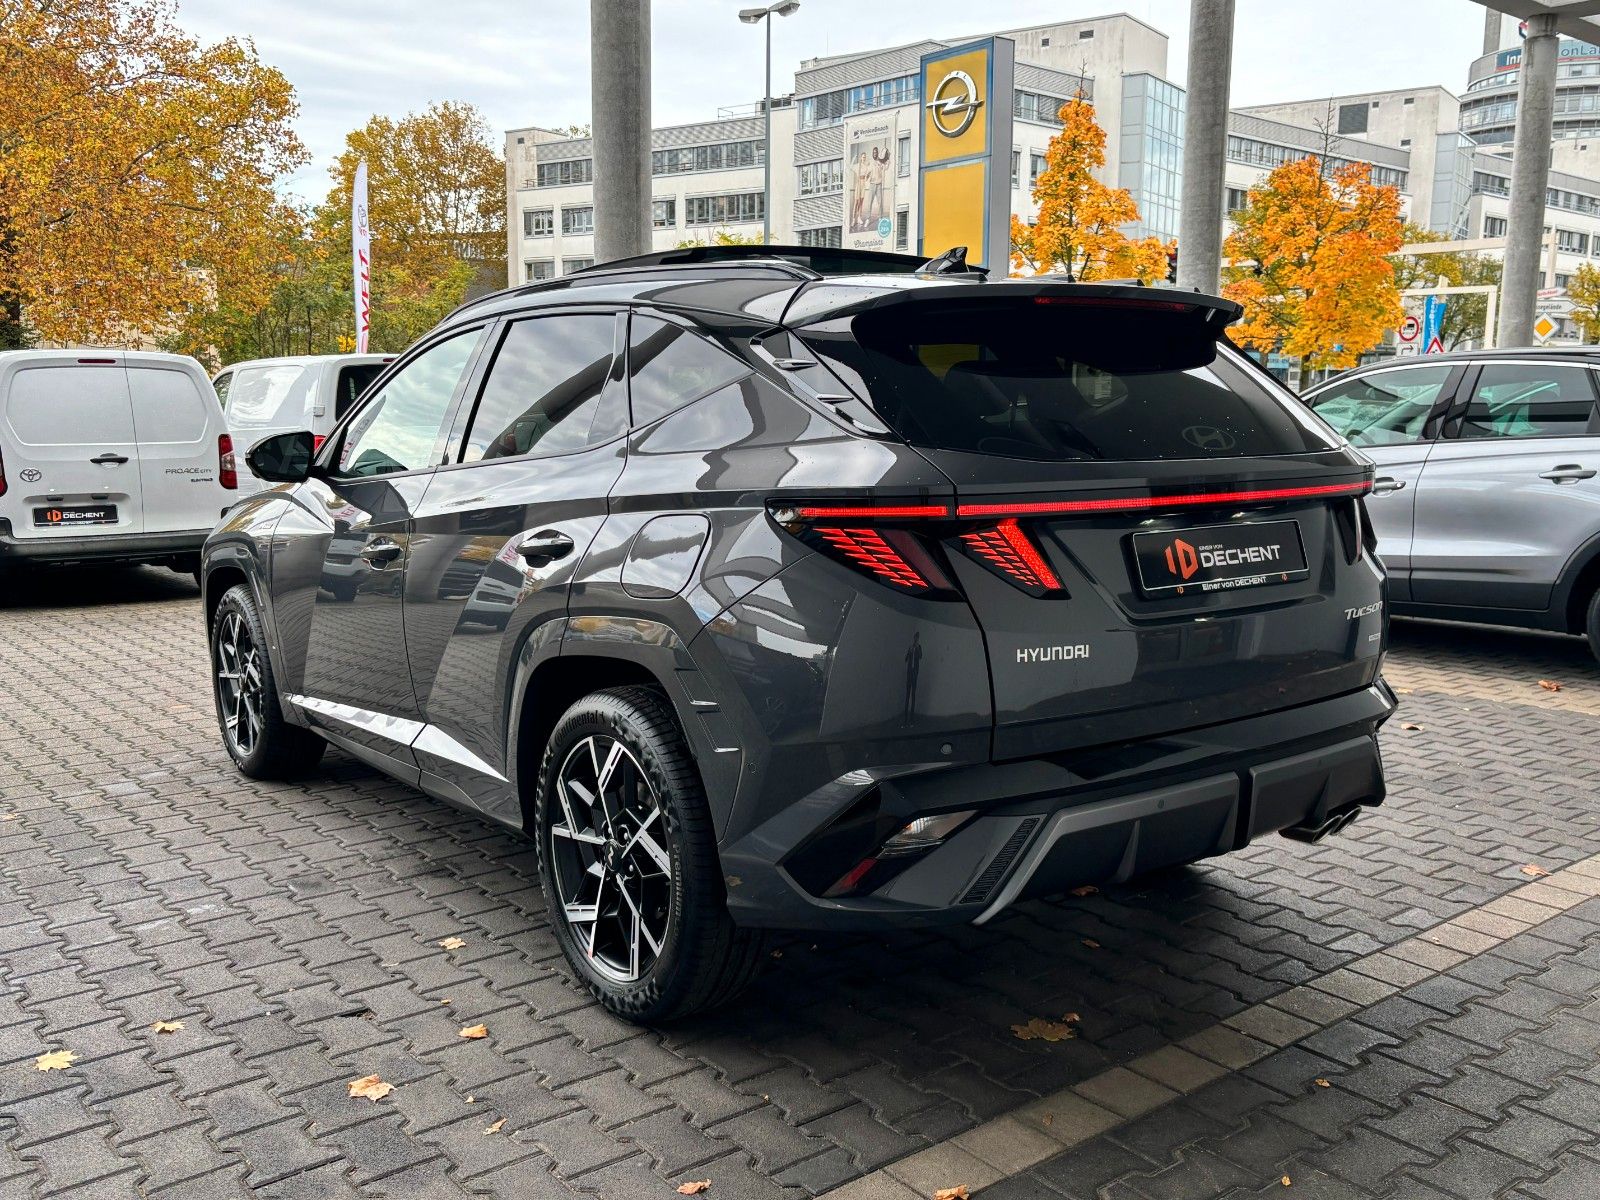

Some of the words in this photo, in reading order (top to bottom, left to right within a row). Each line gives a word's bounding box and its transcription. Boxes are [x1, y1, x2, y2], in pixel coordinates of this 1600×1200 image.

[62, 511, 105, 519] DECHENT
[1200, 544, 1281, 568] DECHENT
[1202, 581, 1220, 591] Einer
[1221, 580, 1235, 588] von
[1235, 576, 1267, 587] DECHENT
[1344, 600, 1383, 620] TUCSON
[1016, 644, 1090, 663] HYUNDAI
